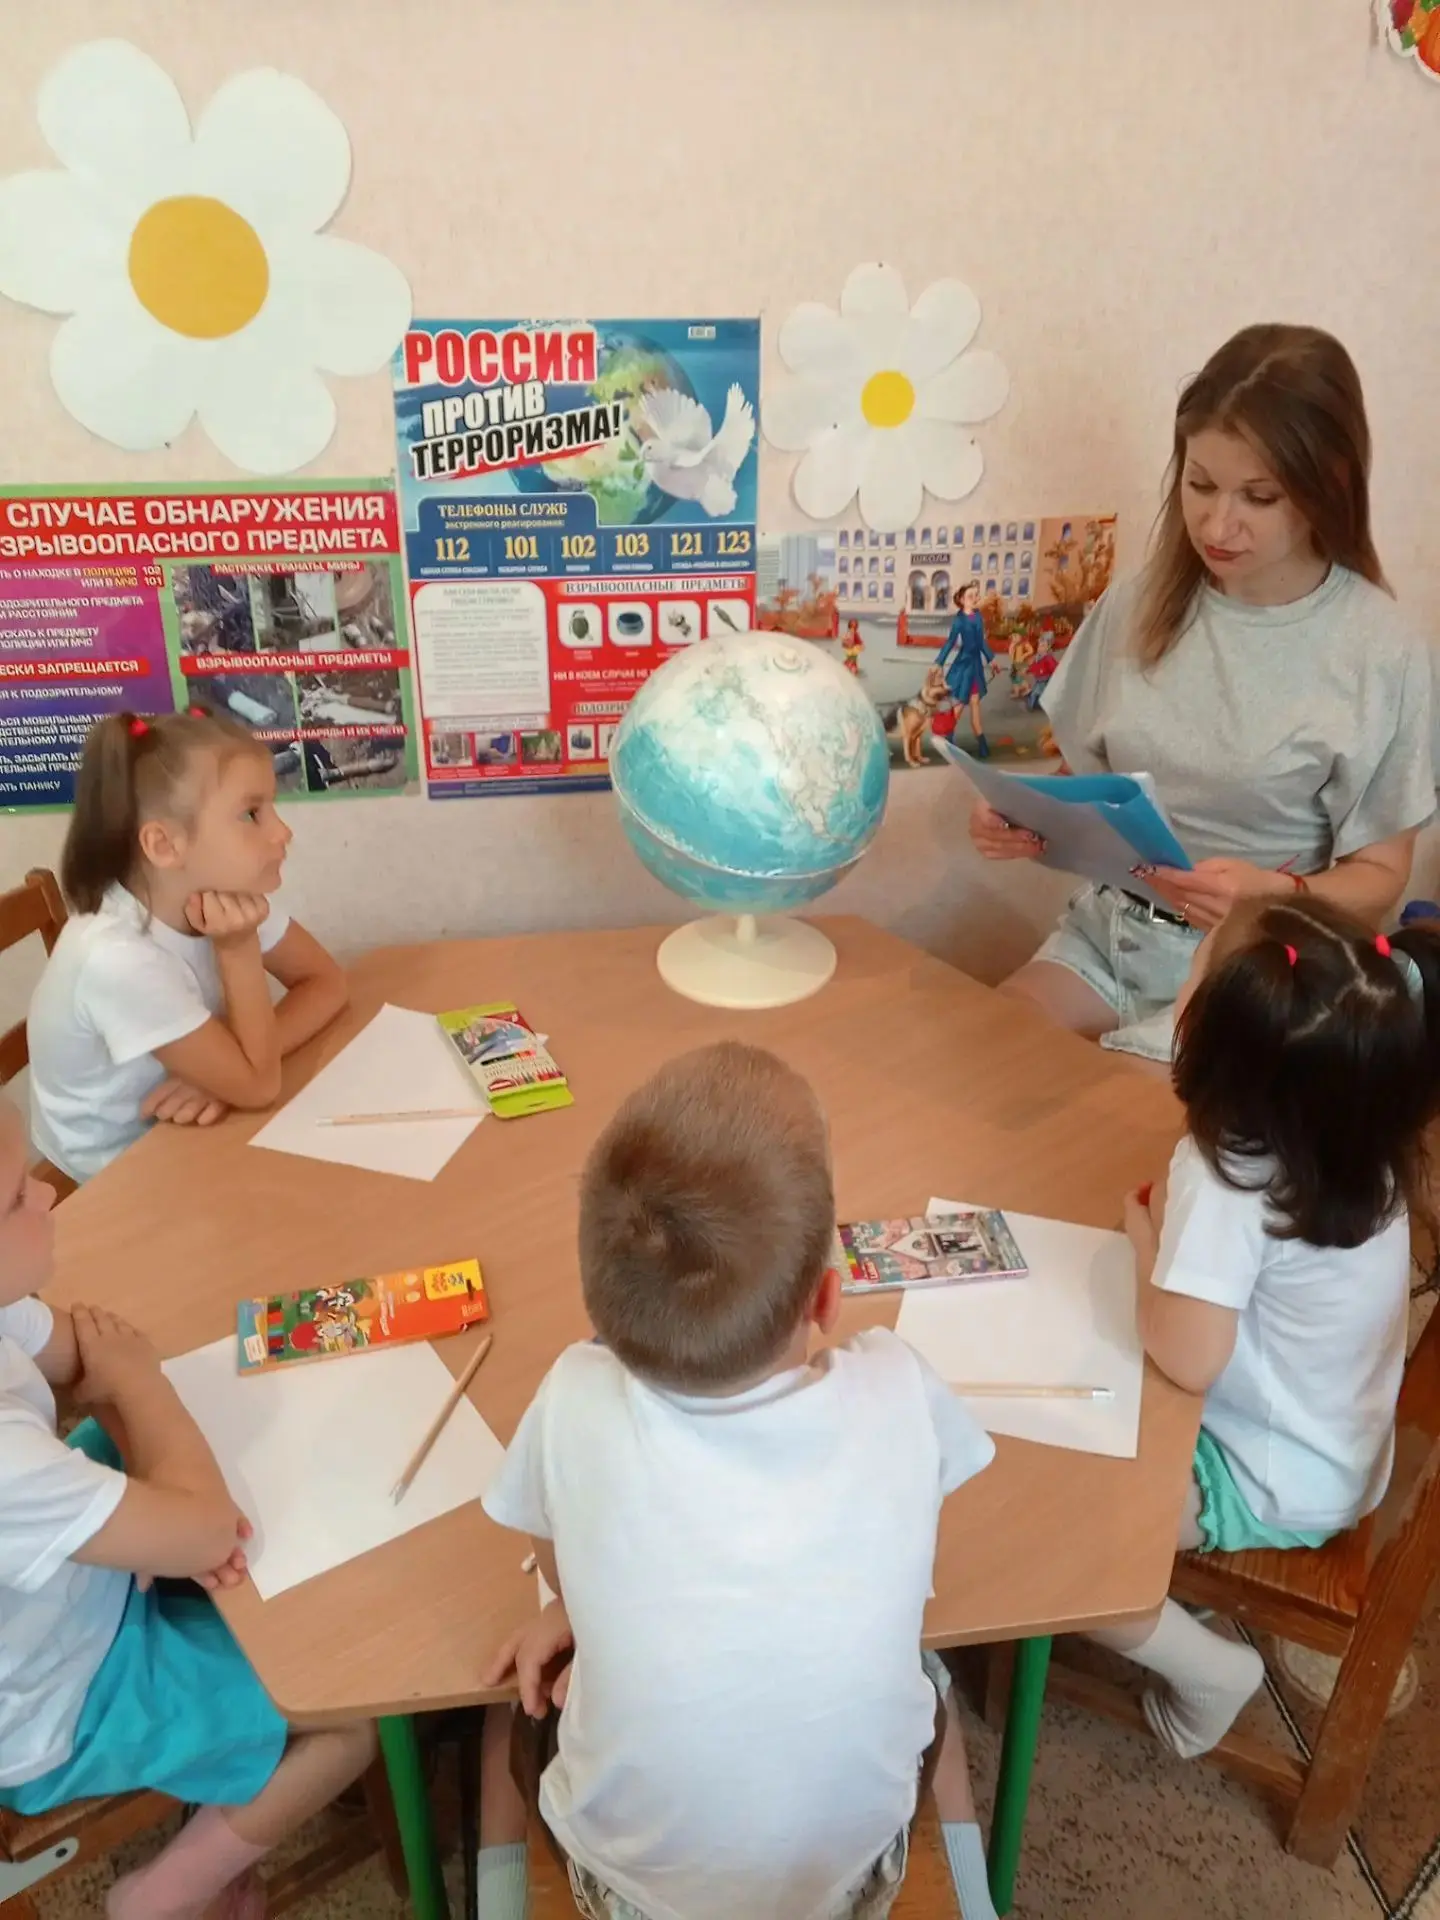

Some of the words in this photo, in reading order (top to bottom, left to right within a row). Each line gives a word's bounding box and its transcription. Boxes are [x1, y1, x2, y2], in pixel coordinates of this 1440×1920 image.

[404, 330, 597, 386] РОССИЯ
[421, 379, 546, 439] ПРОТИВ
[411, 401, 623, 481] ТЕРРОРИЗМА!
[6, 501, 137, 529] СЛУЧАЕ
[144, 496, 386, 526] ОБНАРУЖЕНИЯ
[438, 503, 516, 518] ТЕЛЕФОНЫ
[519, 502, 568, 516] СЛУЖБ
[0, 530, 240, 557] ЗРЫВООПАСНОГО
[246, 528, 388, 553] ПРЕДМЕТА
[435, 536, 470, 562] 112
[504, 535, 539, 560] 101
[561, 534, 597, 558] 102
[615, 532, 650, 557] 103
[671, 531, 703, 556] 121
[717, 530, 751, 555] 123
[144, 577, 163, 586] 101
[566, 580, 674, 593] ВЗРЫВООПАСНЫЕ
[681, 578, 748, 592] ПРЕДМЕТЫ
[91, 596, 144, 607] ПРЕДМЕТА
[47, 627, 99, 638] ПРЕДМЕТУ
[38, 660, 138, 675] ЗАПРЕЩАЕТСЯ
[196, 655, 315, 669] ВЗРЫВООПАСНЫЕ
[318, 652, 392, 667] ПРЕДМЕТЫ
[21, 686, 123, 698] ПОДОЗРИТЕЛЬНОМУ
[22, 714, 92, 726] МОБИЛЬНЫМ
[20, 781, 61, 791] ПАНИКУ
